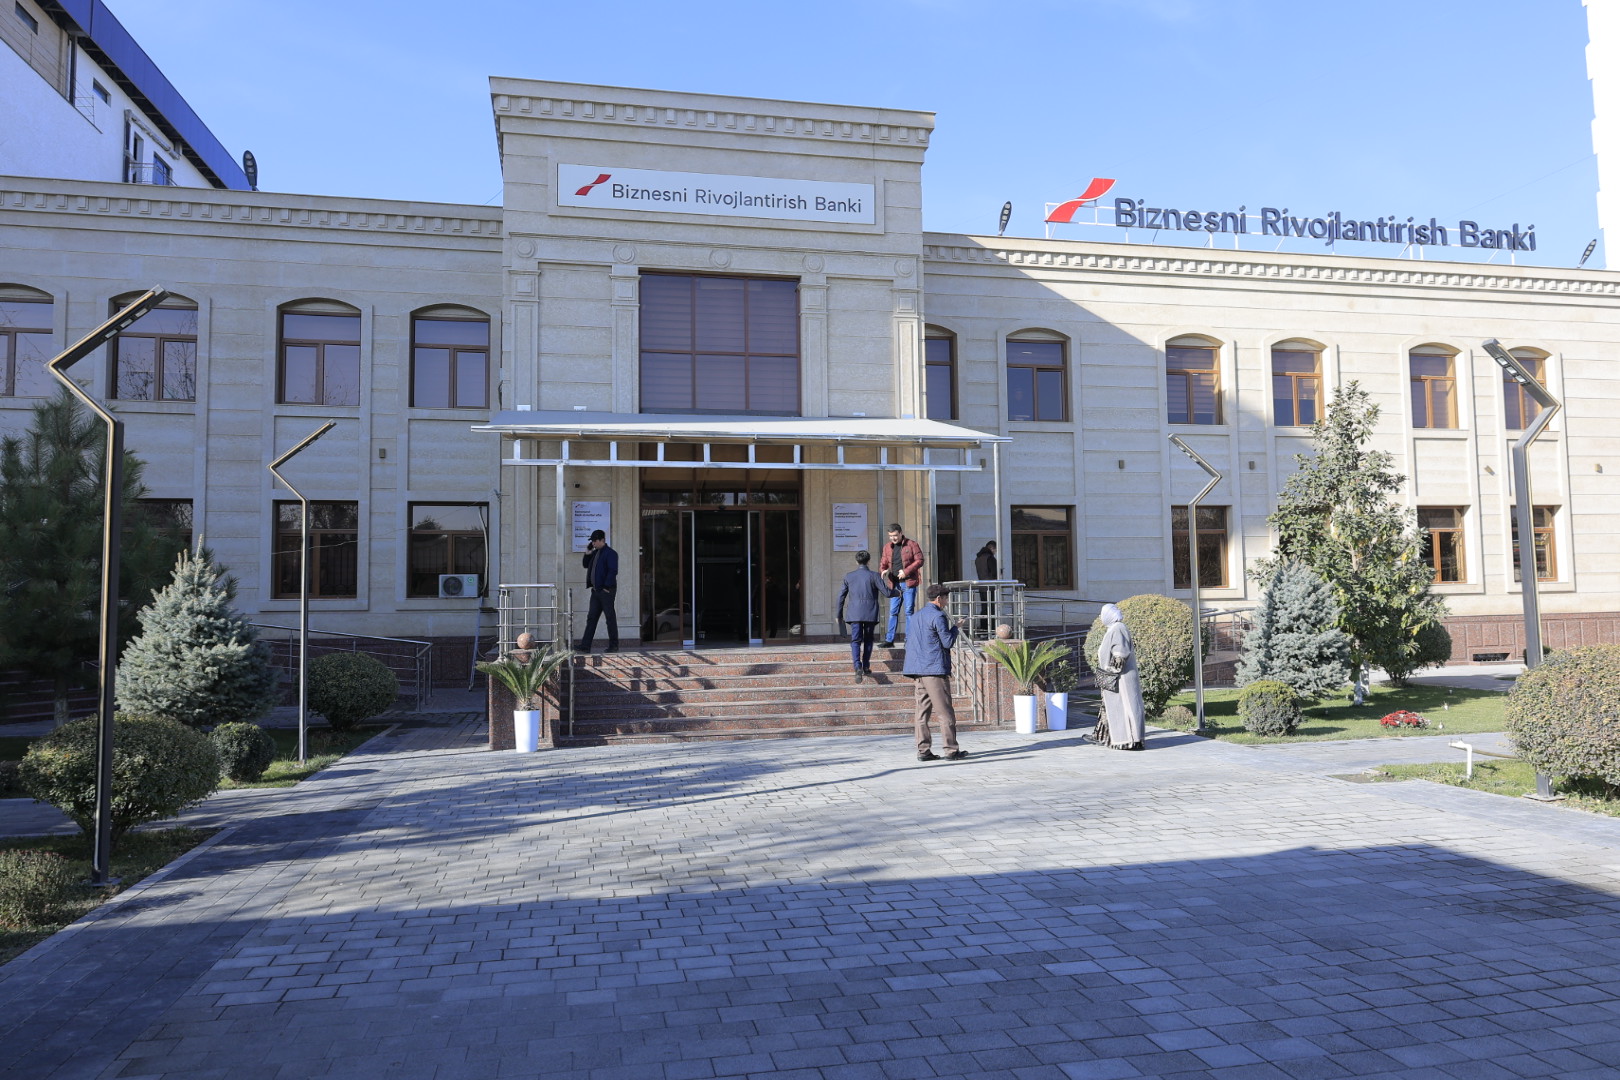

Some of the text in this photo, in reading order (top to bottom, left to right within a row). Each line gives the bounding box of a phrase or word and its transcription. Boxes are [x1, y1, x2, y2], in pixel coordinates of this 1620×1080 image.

[612, 184, 862, 213] Biznesni Rivojlantirish Banki
[1114, 197, 1536, 251] Biznesni Rivojlantirish Banki
